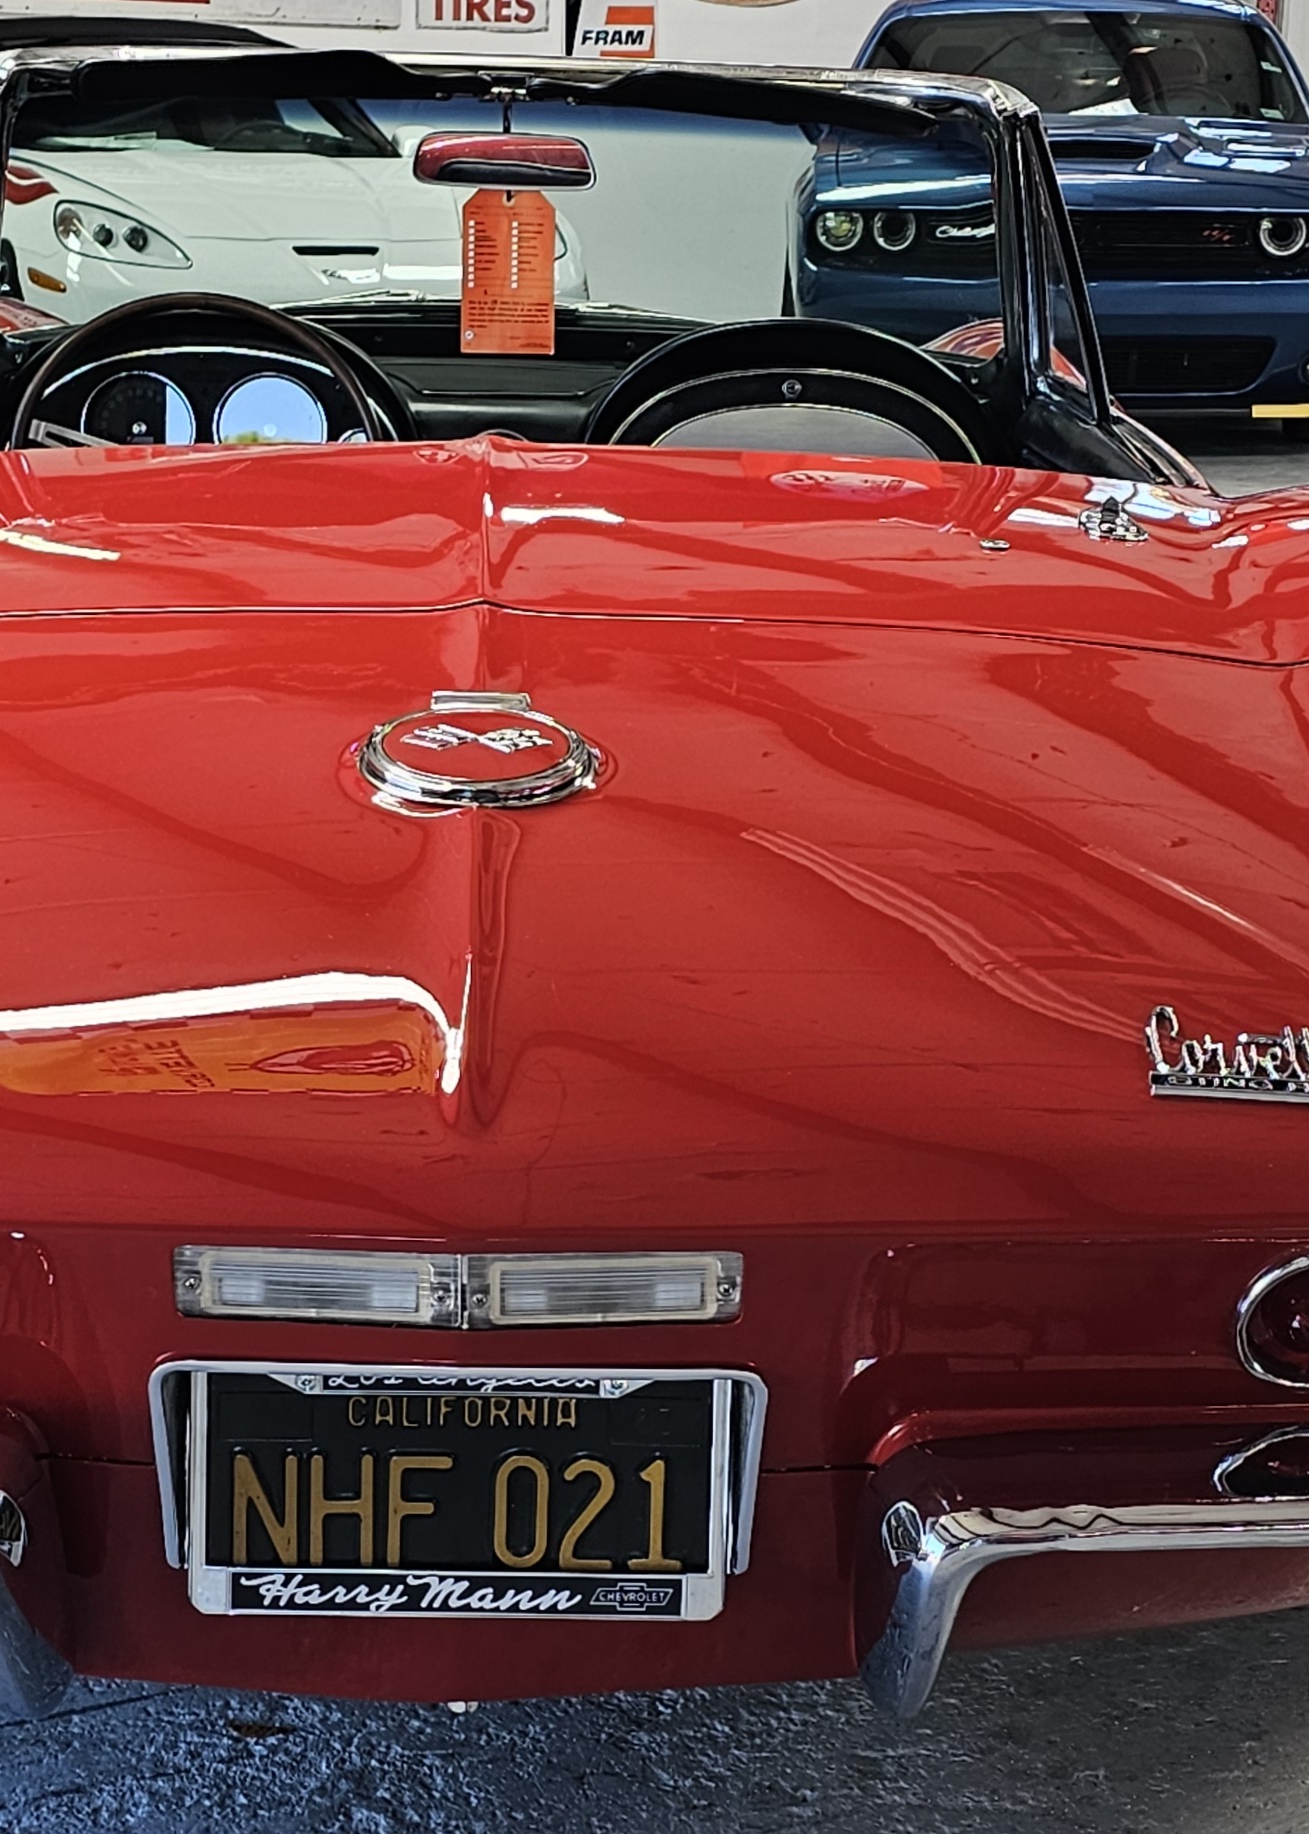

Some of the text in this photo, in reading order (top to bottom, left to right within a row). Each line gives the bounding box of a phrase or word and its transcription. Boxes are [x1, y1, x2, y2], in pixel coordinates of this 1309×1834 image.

[435, 0, 536, 23] TIRES
[581, 30, 645, 46] FRAM
[348, 1396, 576, 1428] CALIFORNIA
[232, 1453, 683, 1571] NHF 021
[240, 1574, 582, 1613] Harry Mann
[598, 1591, 665, 1602] CHEVROLET
